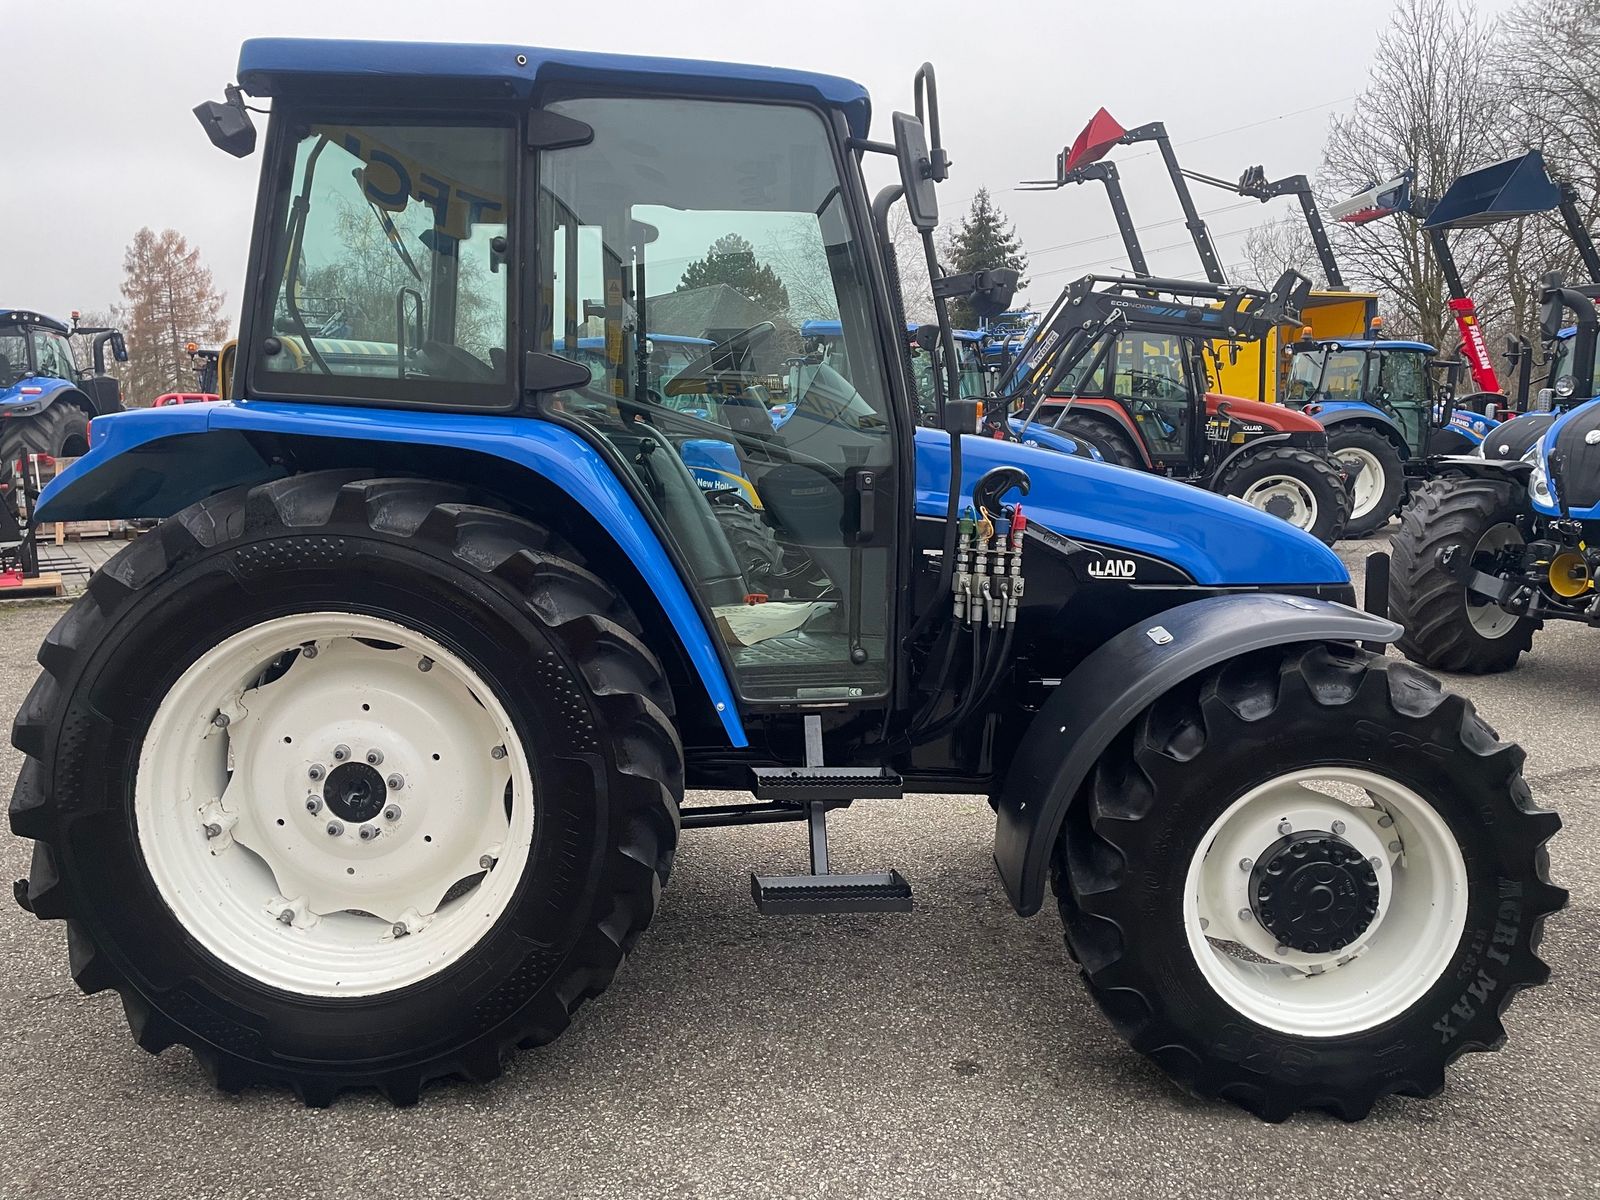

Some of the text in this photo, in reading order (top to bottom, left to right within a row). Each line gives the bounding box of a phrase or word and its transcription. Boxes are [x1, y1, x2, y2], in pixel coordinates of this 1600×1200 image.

[1110, 300, 1157, 310] ECONOMY
[1033, 333, 1058, 363] HYDRAC
[1468, 324, 1492, 370] FARESIN
[697, 478, 743, 497] New Holld
[1087, 559, 1137, 577] LLAND
[1432, 875, 1523, 1045] AGRI MAX
